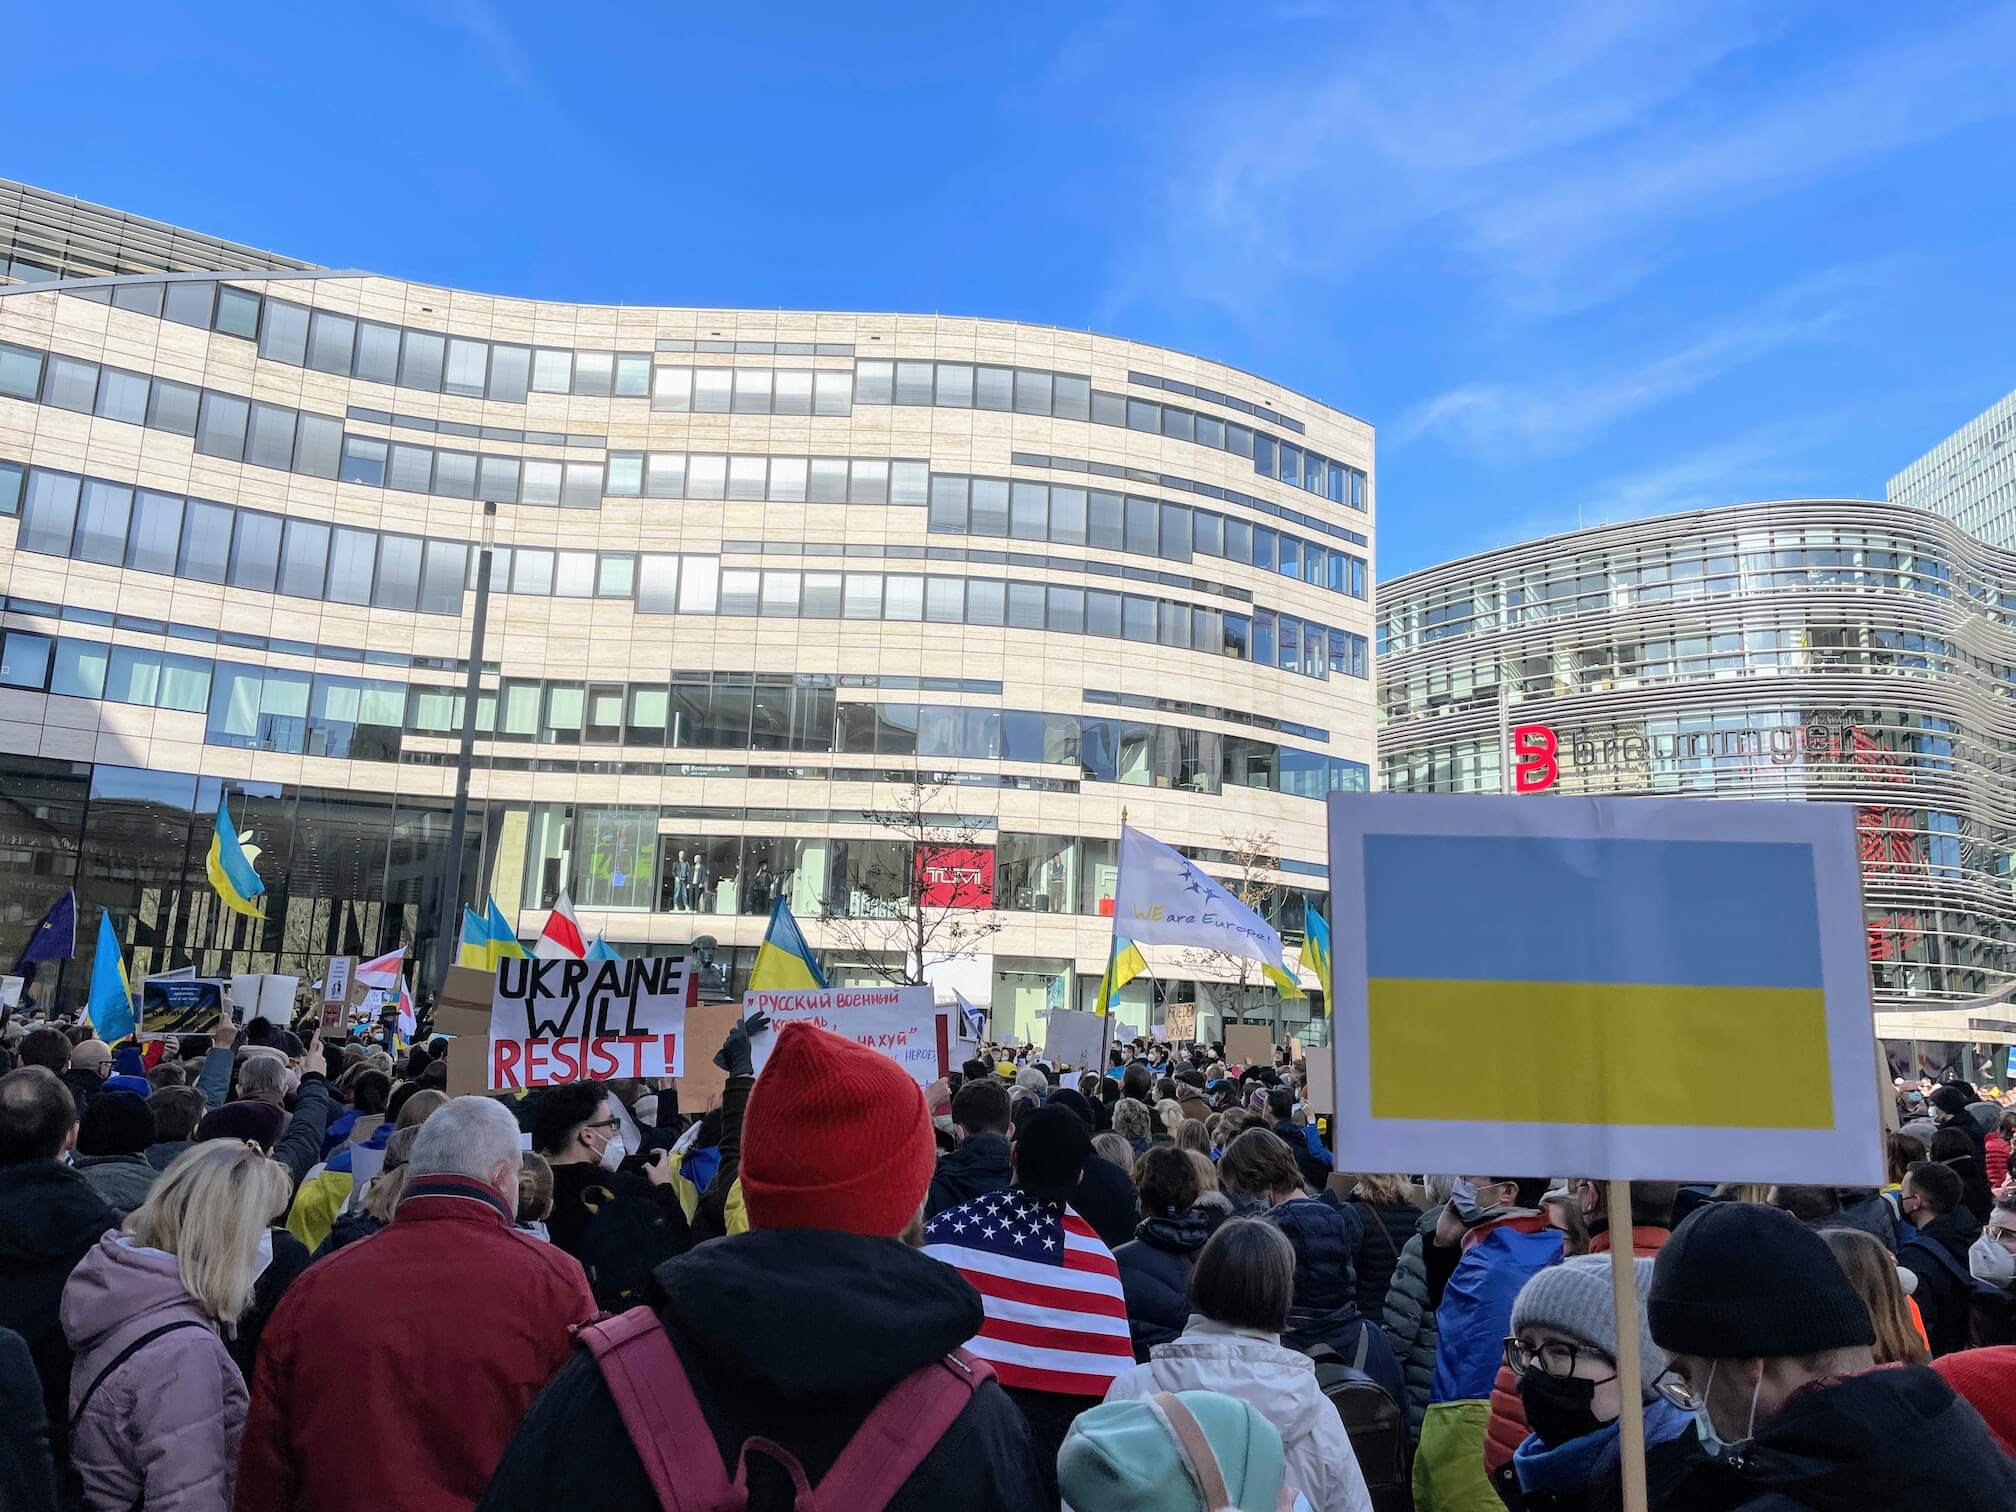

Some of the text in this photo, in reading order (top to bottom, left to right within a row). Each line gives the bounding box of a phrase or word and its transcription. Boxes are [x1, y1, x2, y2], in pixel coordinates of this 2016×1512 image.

[1166, 914, 1196, 923] are
[499, 956, 684, 1000] UKRAINE
[524, 992, 649, 1040] WILL
[494, 1033, 676, 1088] RESIST!
